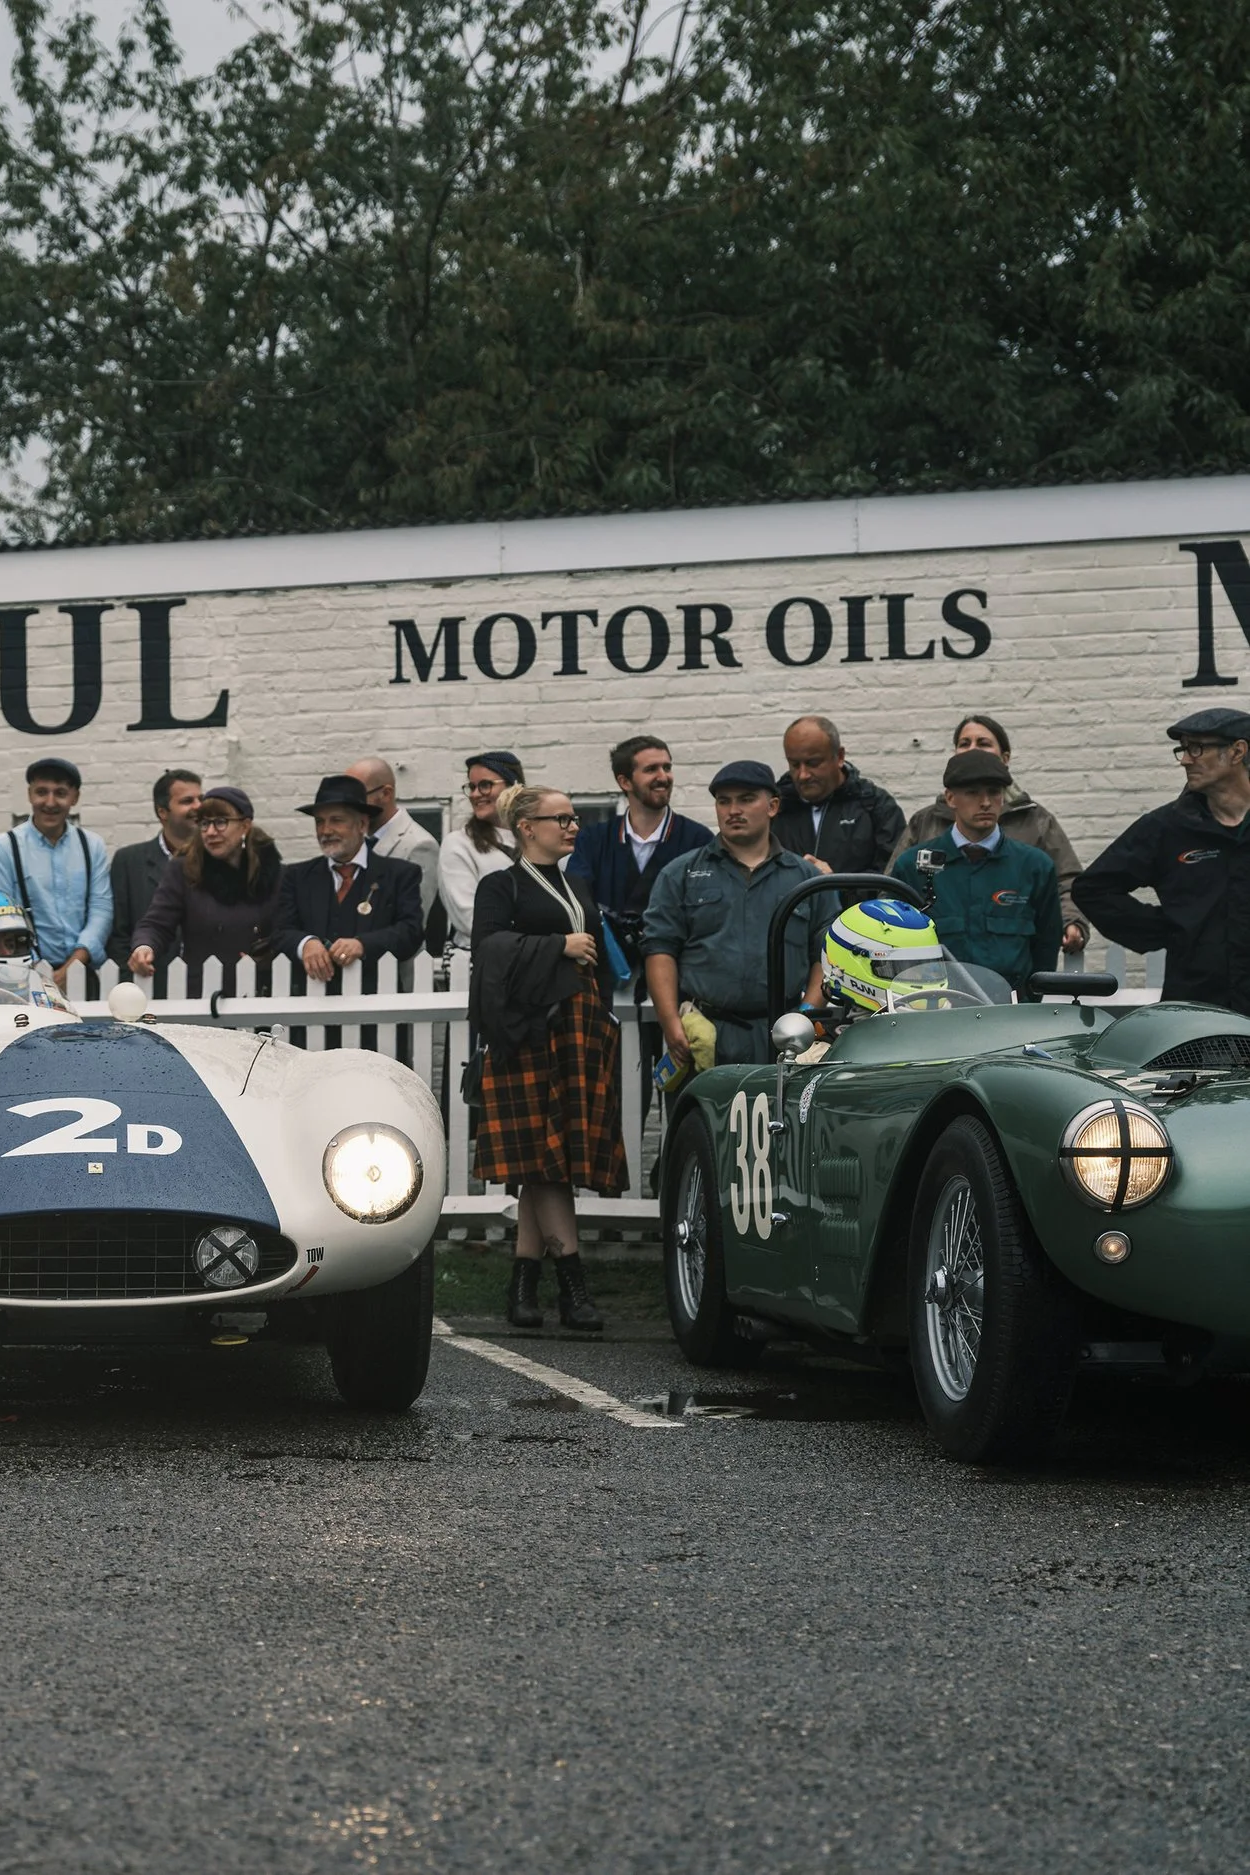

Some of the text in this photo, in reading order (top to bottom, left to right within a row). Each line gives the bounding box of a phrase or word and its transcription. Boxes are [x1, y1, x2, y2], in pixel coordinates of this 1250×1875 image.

[387, 589, 993, 685] MOTOR OILS
[850, 979, 876, 997] RJW
[729, 1090, 773, 1241] 38
[306, 1246, 324, 1264] TOW
